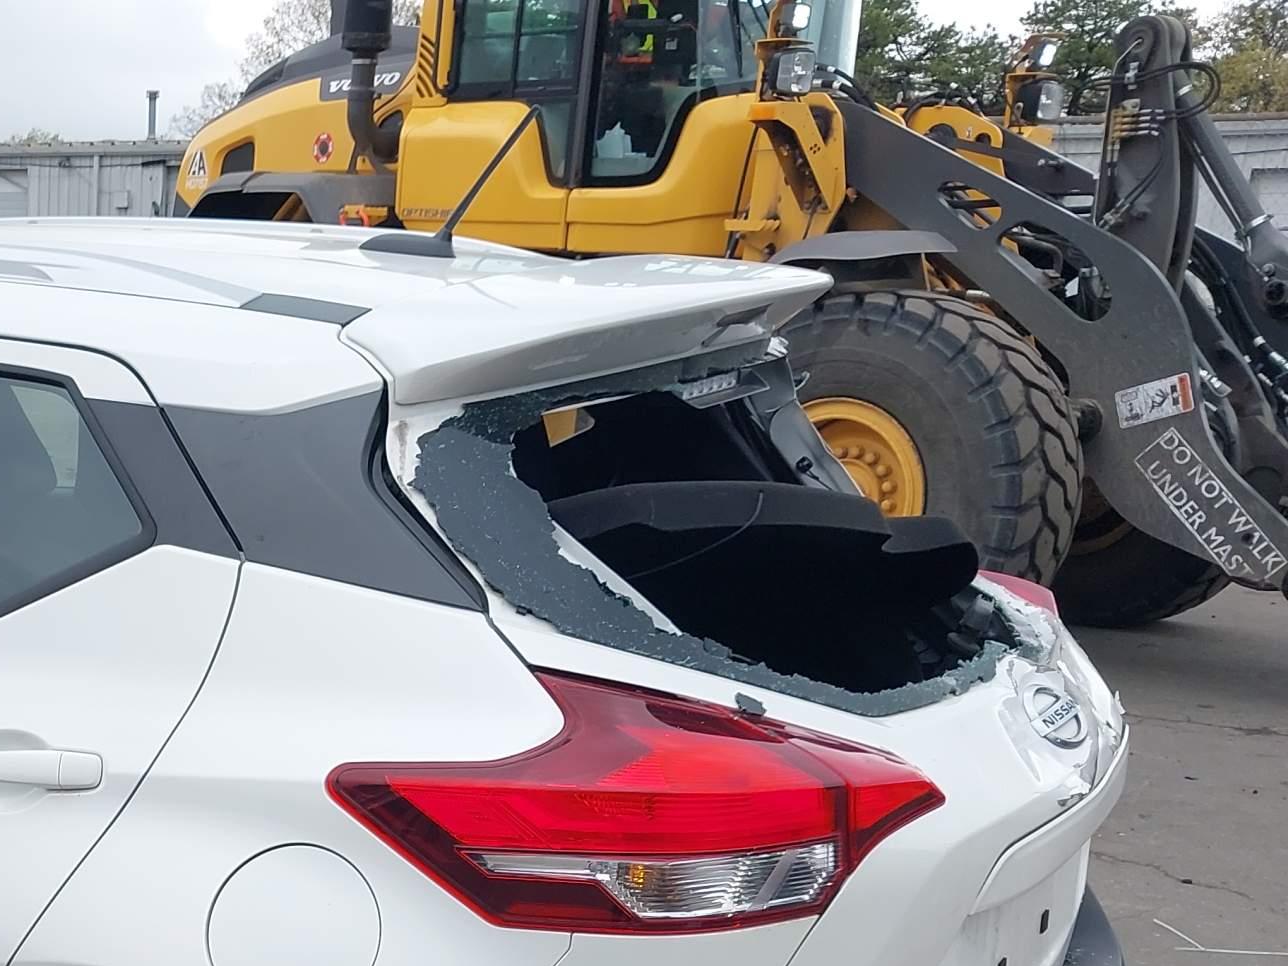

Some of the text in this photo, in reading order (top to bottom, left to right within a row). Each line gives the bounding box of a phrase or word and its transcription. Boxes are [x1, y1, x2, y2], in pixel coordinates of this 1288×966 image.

[329, 72, 401, 93] VOVO
[1159, 432, 1192, 465] DO
[1186, 463, 1233, 509] NOT
[1147, 460, 1254, 576] UNDER MAST
